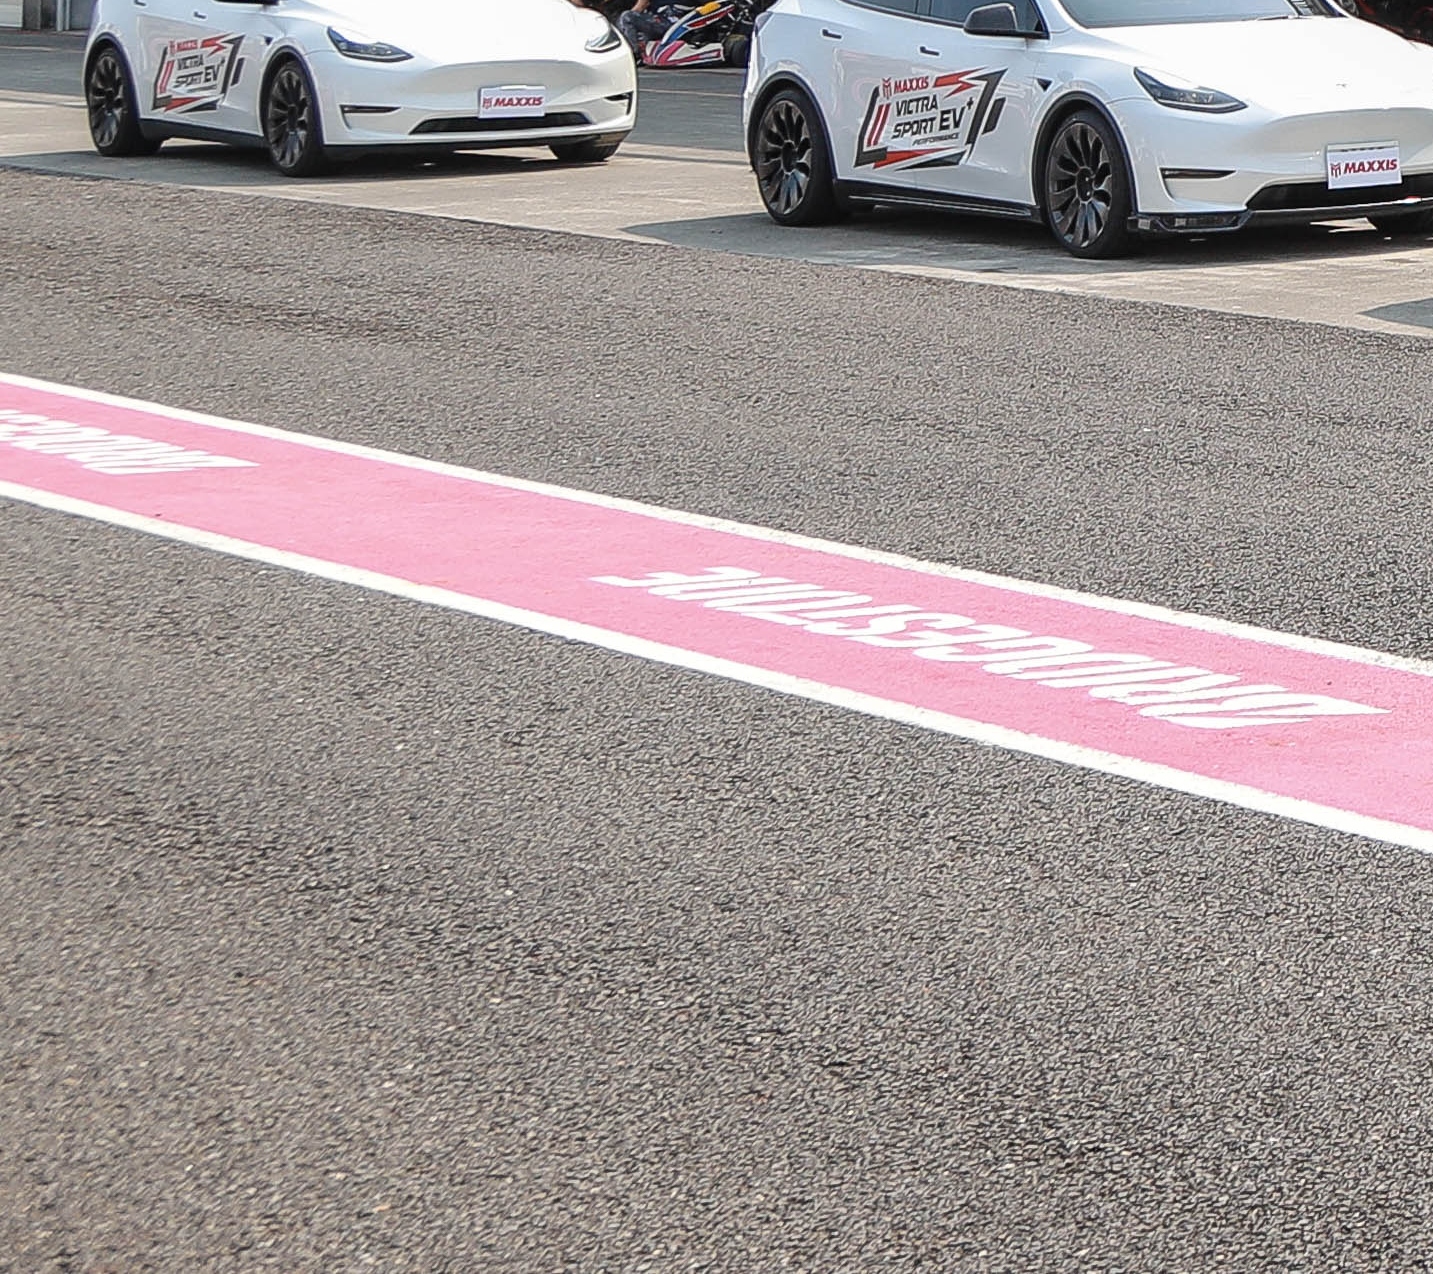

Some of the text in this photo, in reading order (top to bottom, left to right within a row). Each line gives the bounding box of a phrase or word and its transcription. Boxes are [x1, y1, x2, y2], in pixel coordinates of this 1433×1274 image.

[894, 75, 929, 95] MAXXIS
[491, 95, 544, 109] MAXXIS
[896, 94, 938, 116] VICTRA
[891, 117, 937, 139] SPORT
[1344, 159, 1398, 175] MAXXIS
[598, 565, 1393, 729] BRIDGESTONE
